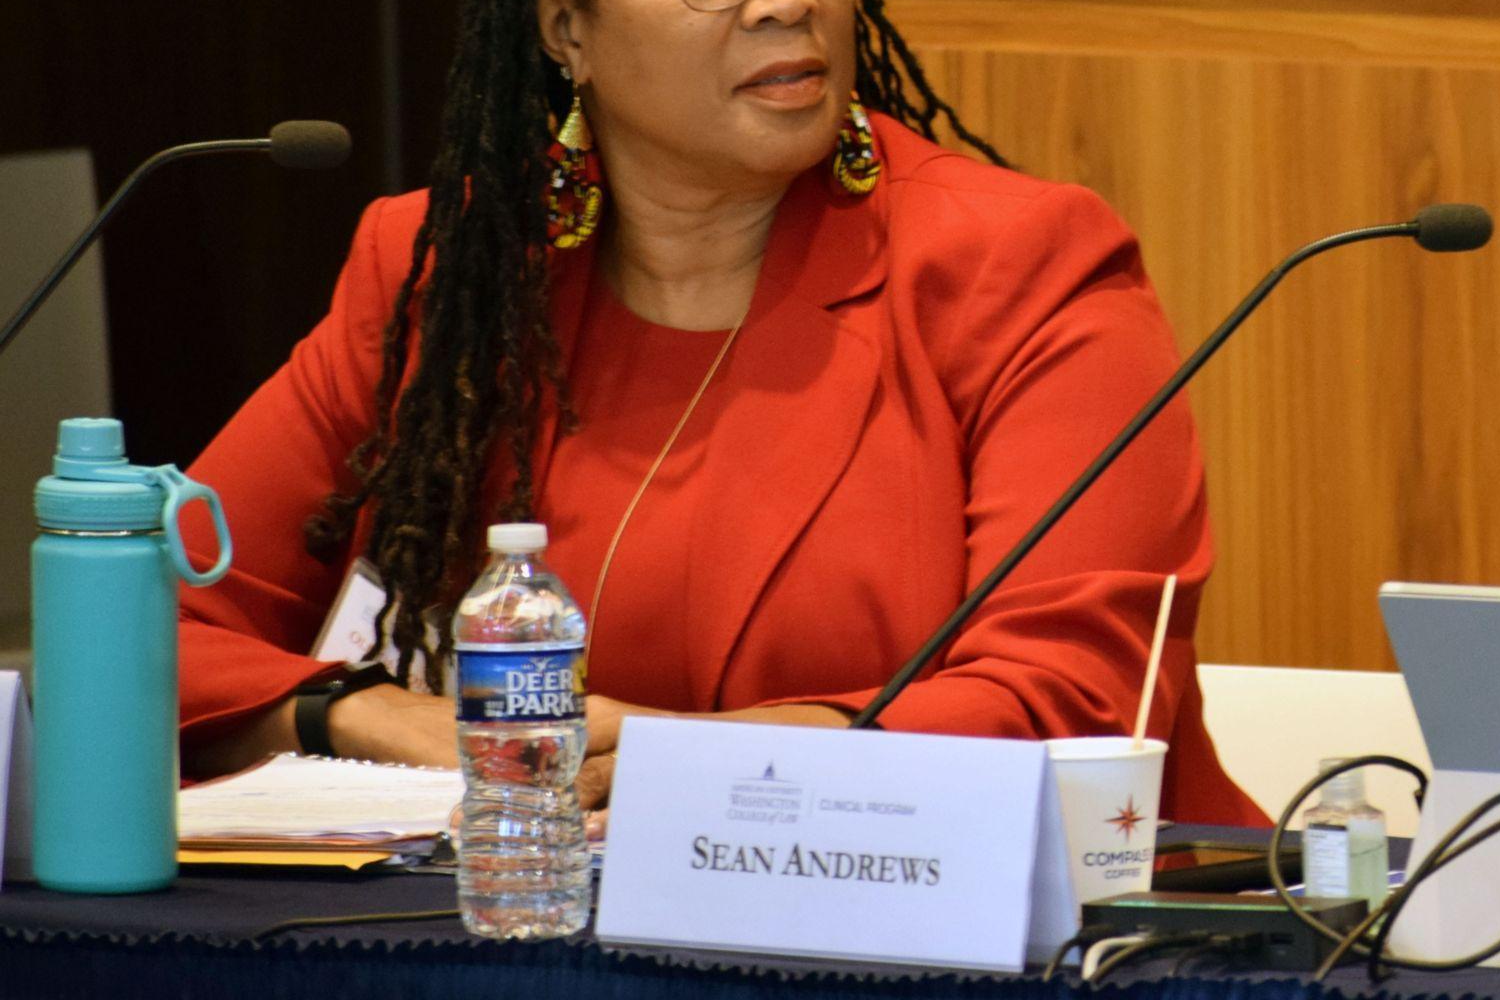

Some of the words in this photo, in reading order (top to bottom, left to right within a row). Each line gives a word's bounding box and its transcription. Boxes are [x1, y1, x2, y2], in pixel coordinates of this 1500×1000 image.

[505, 668, 574, 692] DEER
[506, 692, 576, 717] PARK
[691, 835, 775, 875] SEAN
[781, 842, 942, 887] ANDREWS
